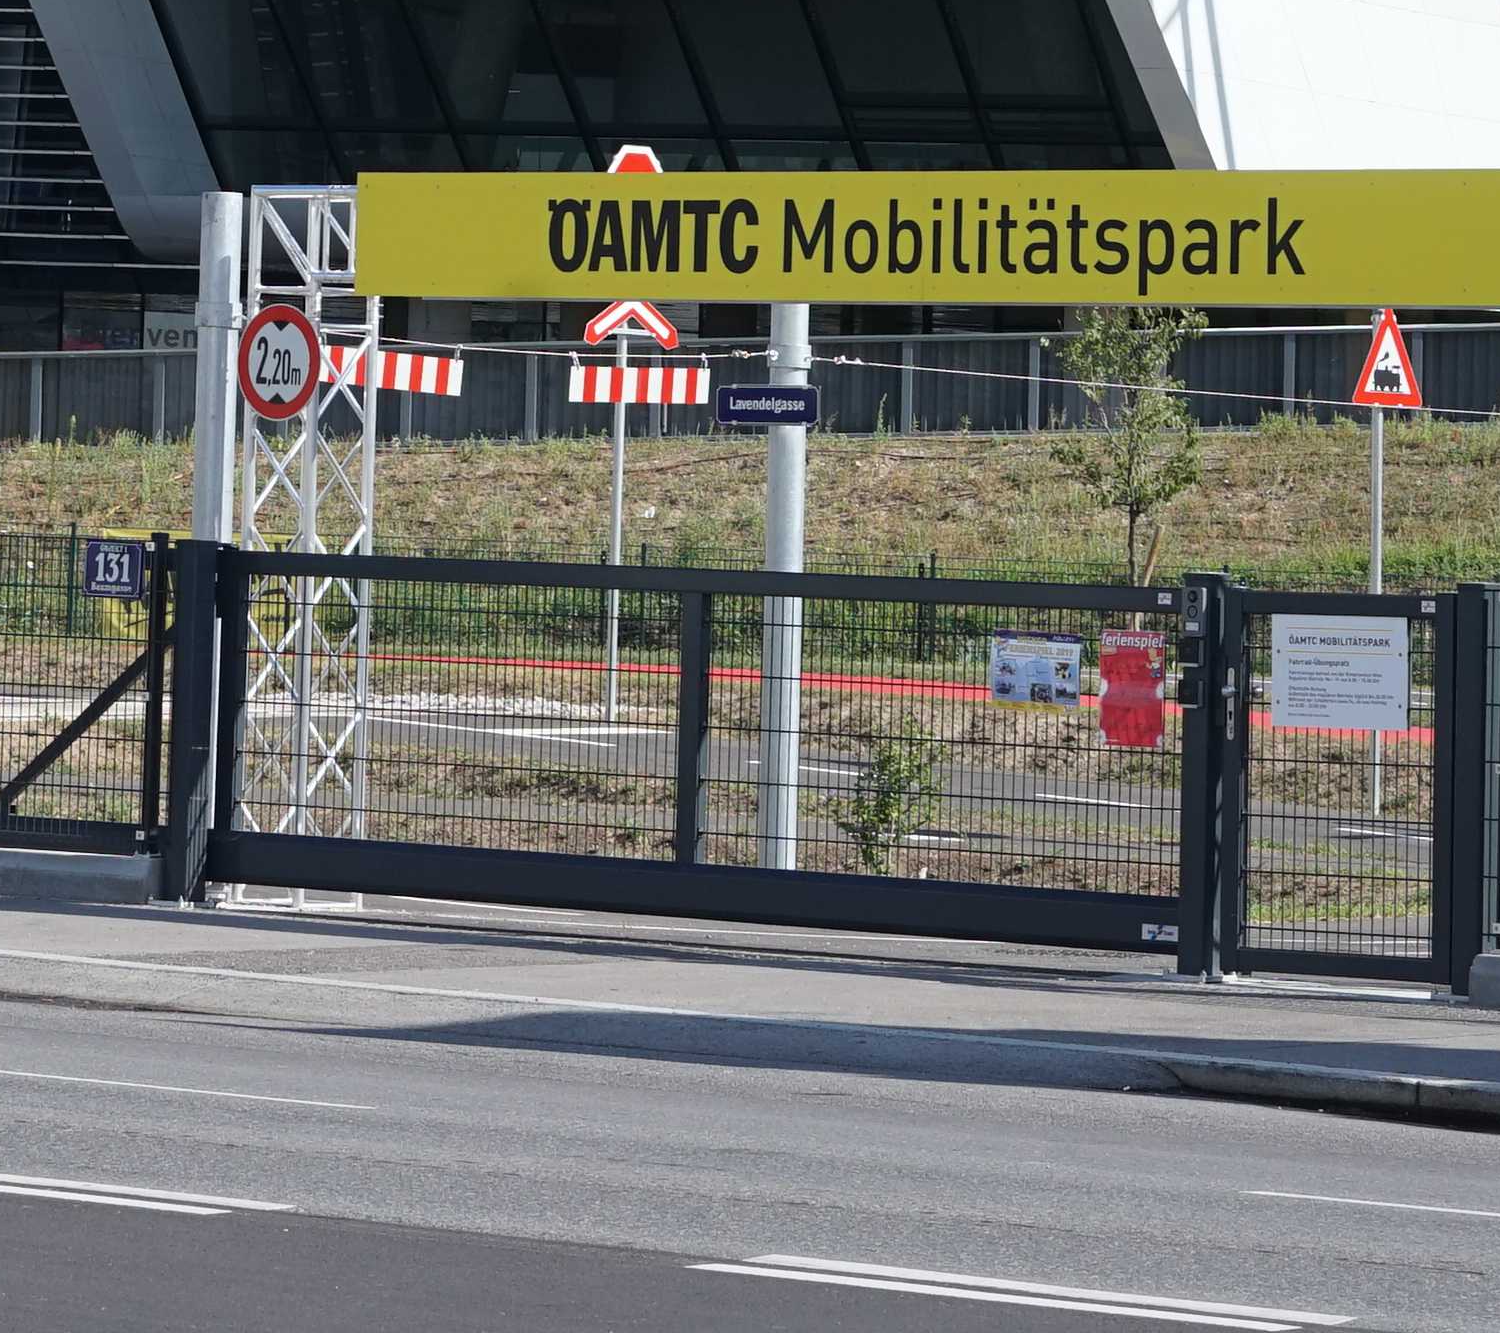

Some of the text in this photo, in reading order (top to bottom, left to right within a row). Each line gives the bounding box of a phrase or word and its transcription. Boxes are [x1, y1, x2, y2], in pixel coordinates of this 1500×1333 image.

[549, 197, 1306, 296] ÖAMTC Mobilitätspark
[729, 396, 805, 414] Lavendelgasse
[95, 552, 130, 583] 131
[1101, 632, 1164, 651] ferienspiel
[1288, 634, 1391, 648] ÖAMTC MOBILITÄTSPARK
